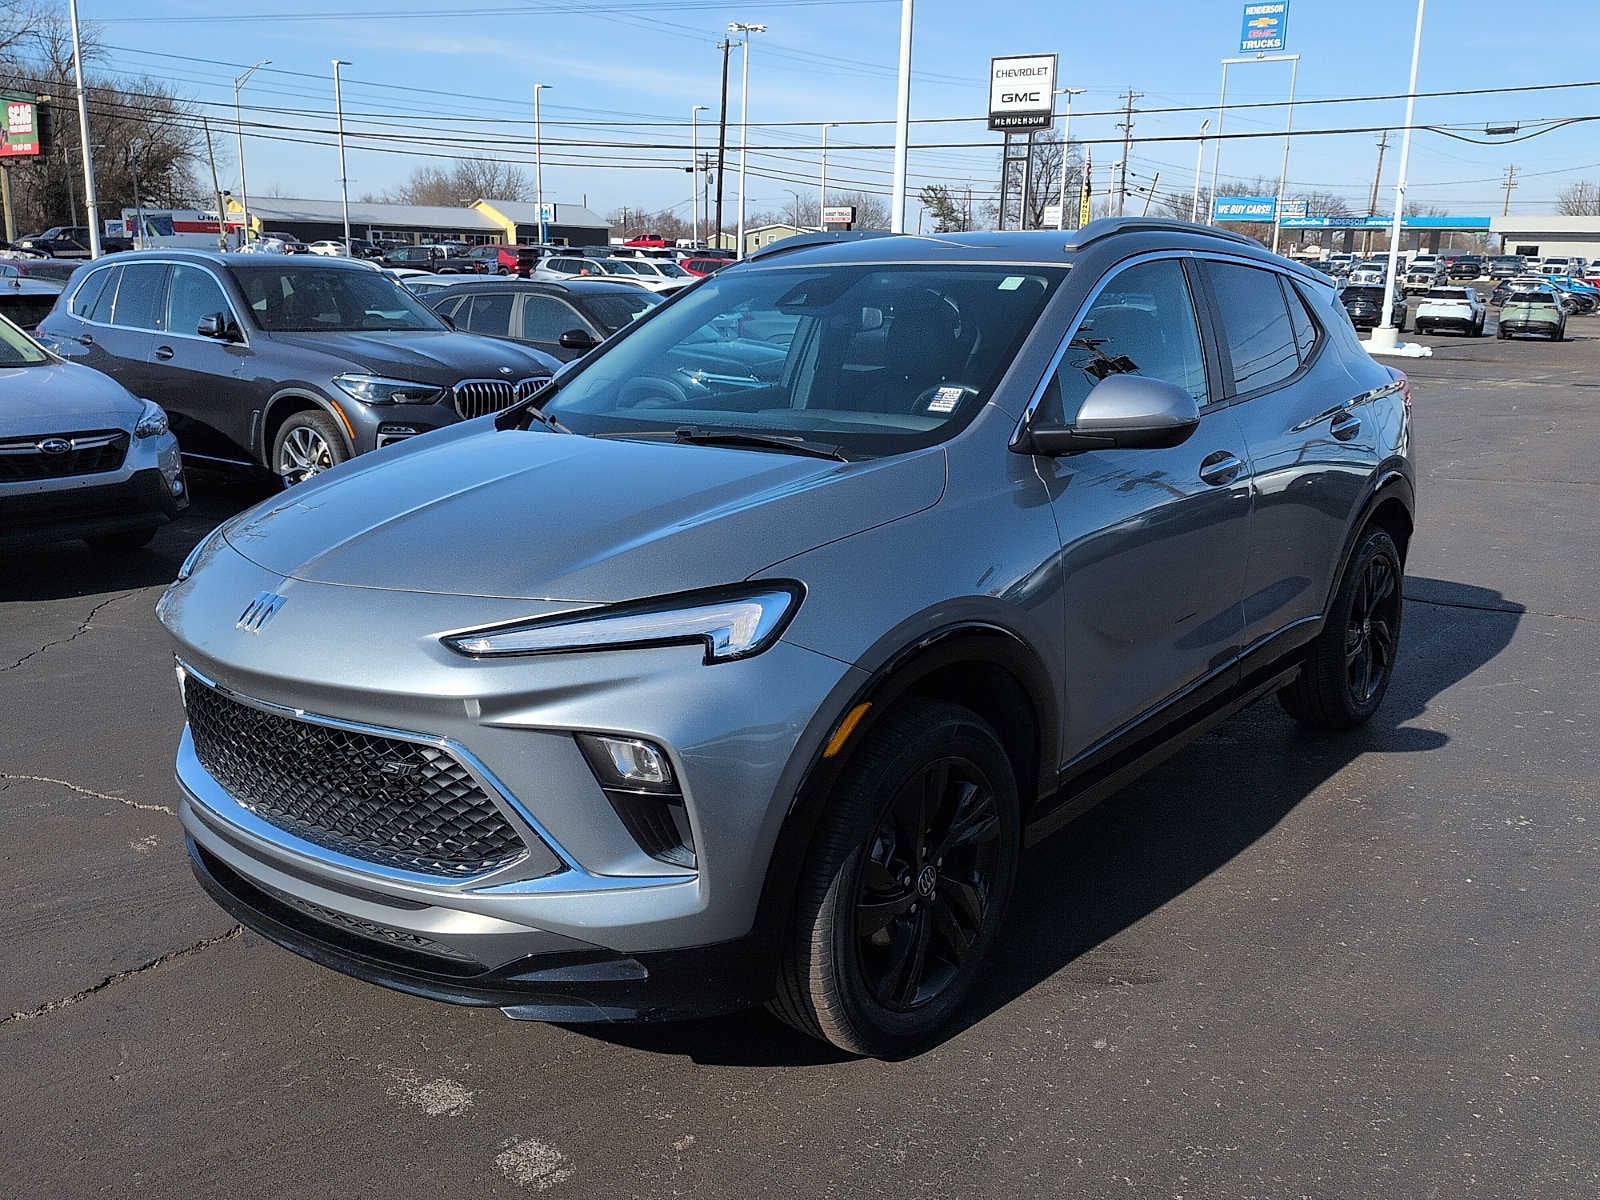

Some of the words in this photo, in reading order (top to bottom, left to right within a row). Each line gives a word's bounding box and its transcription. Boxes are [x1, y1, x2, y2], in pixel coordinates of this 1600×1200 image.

[1242, 39, 1281, 49] TRUCKS
[996, 67, 1048, 78] CHEVROLET
[1002, 92, 1040, 103] GMC
[994, 116, 1045, 126] HENDERSON
[1217, 204, 1231, 214] WE
[1230, 204, 1247, 214] BUY
[1246, 204, 1272, 214] CARS!!
